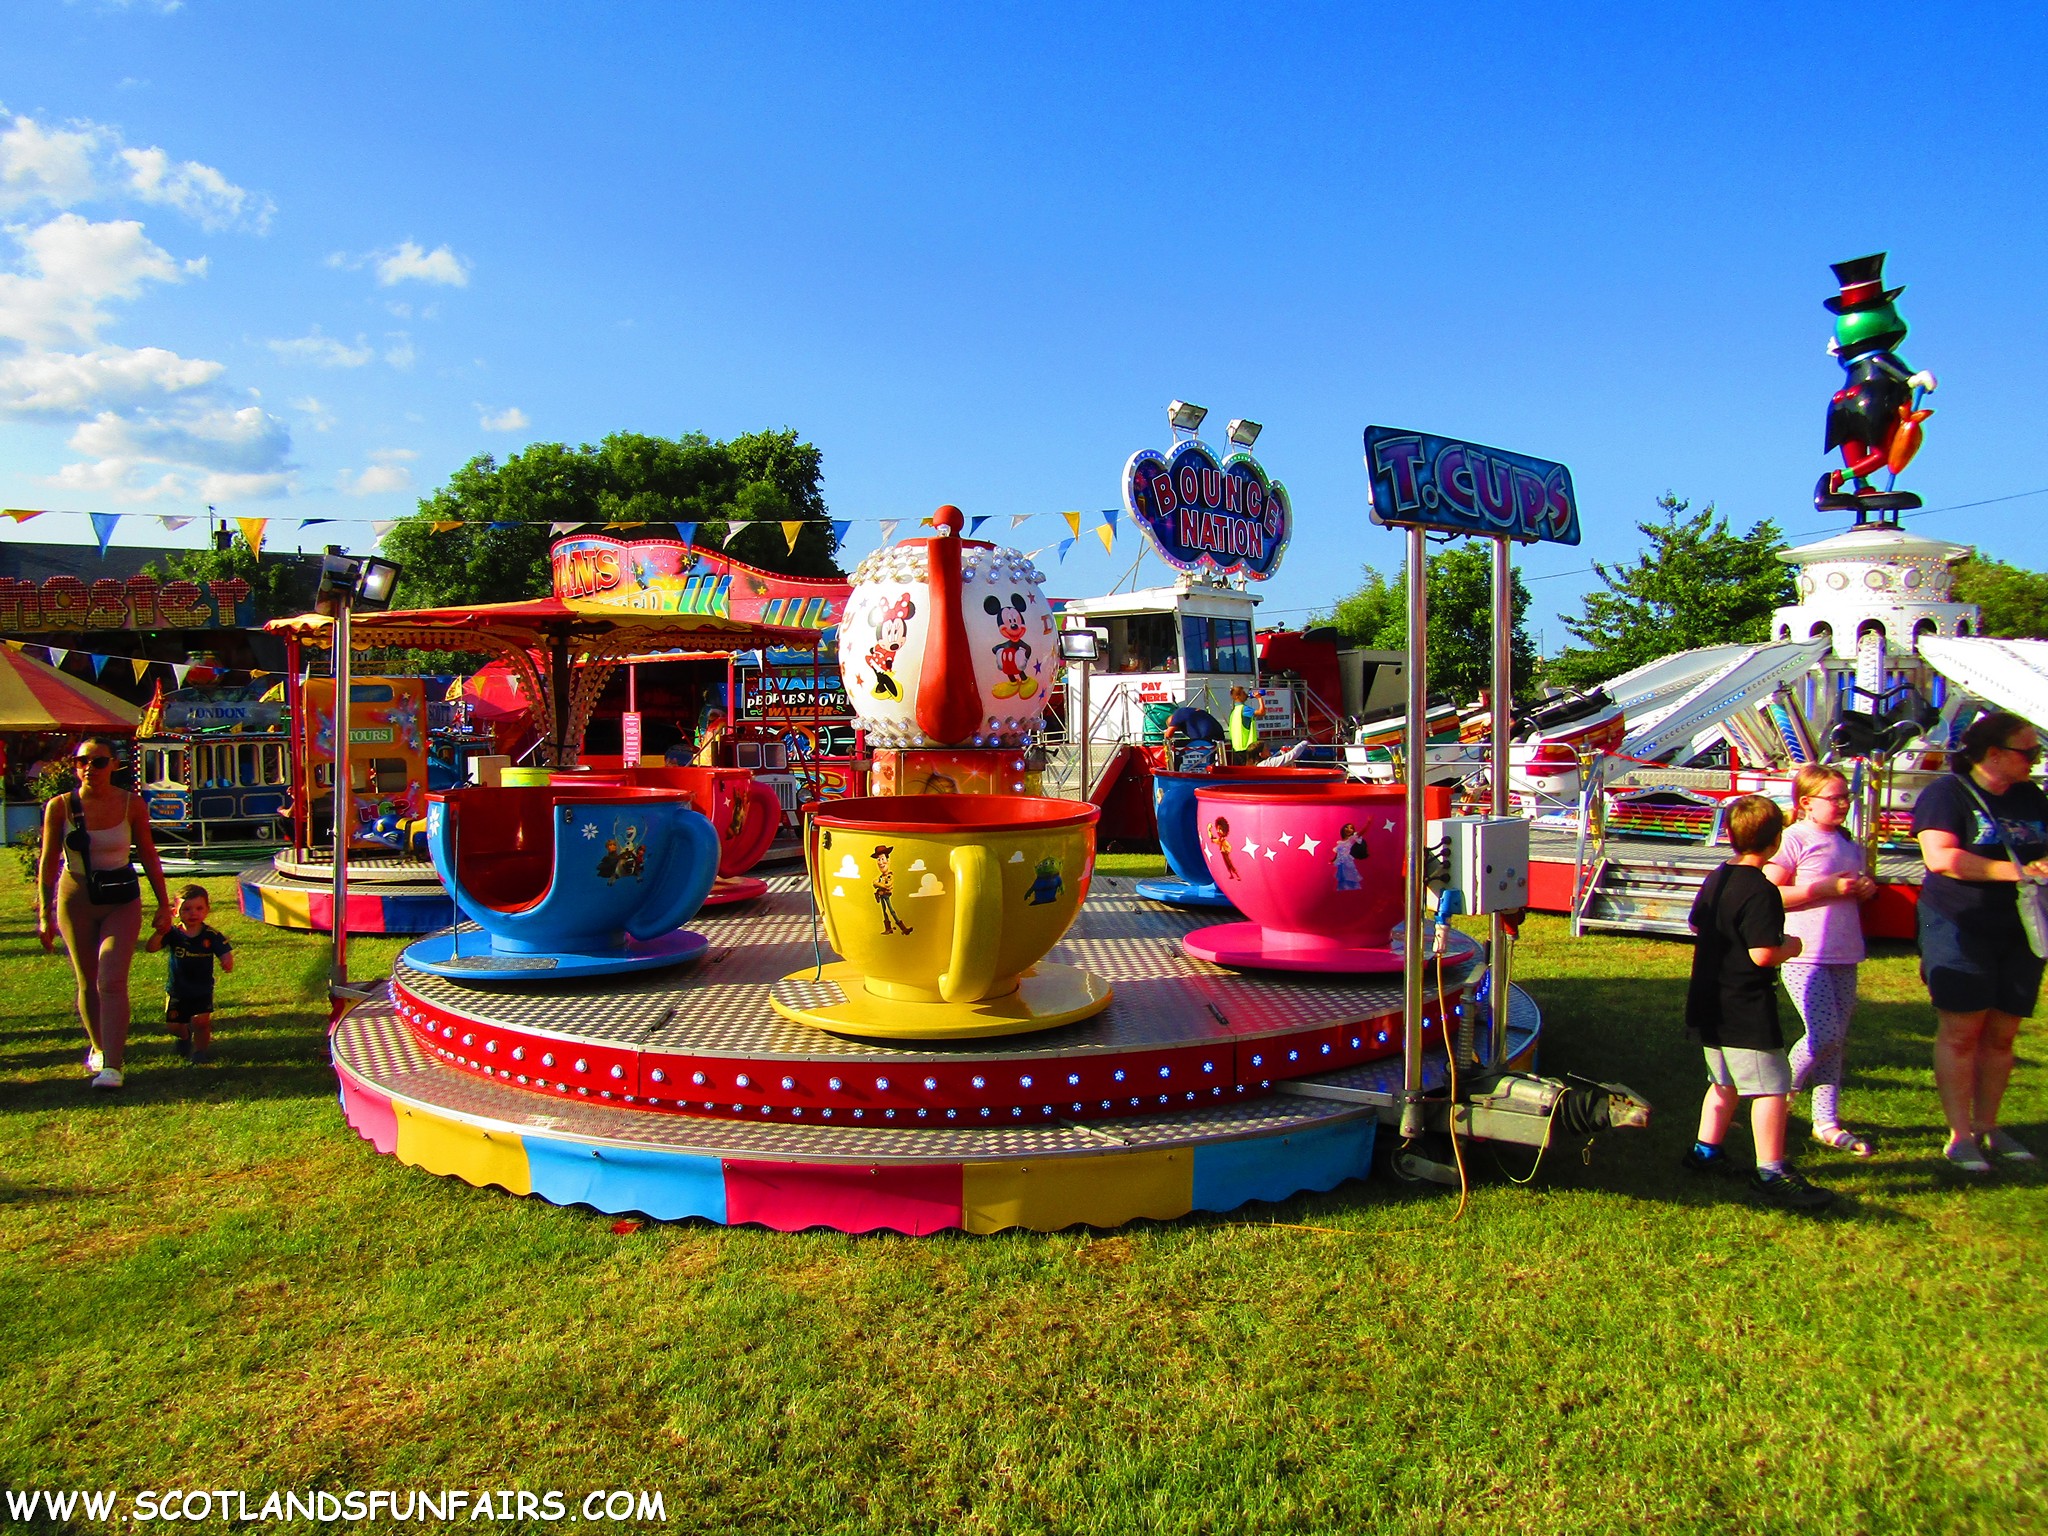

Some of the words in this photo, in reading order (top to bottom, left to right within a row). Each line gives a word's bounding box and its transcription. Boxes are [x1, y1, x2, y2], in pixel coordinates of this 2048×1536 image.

[1152, 466, 1279, 537] BOUNCE
[1373, 435, 1572, 539] T.CUPS
[1180, 507, 1264, 559] NATION
[759, 675, 841, 691] EVANS
[1141, 682, 1161, 691] PAY
[768, 706, 834, 717] WALTZER
